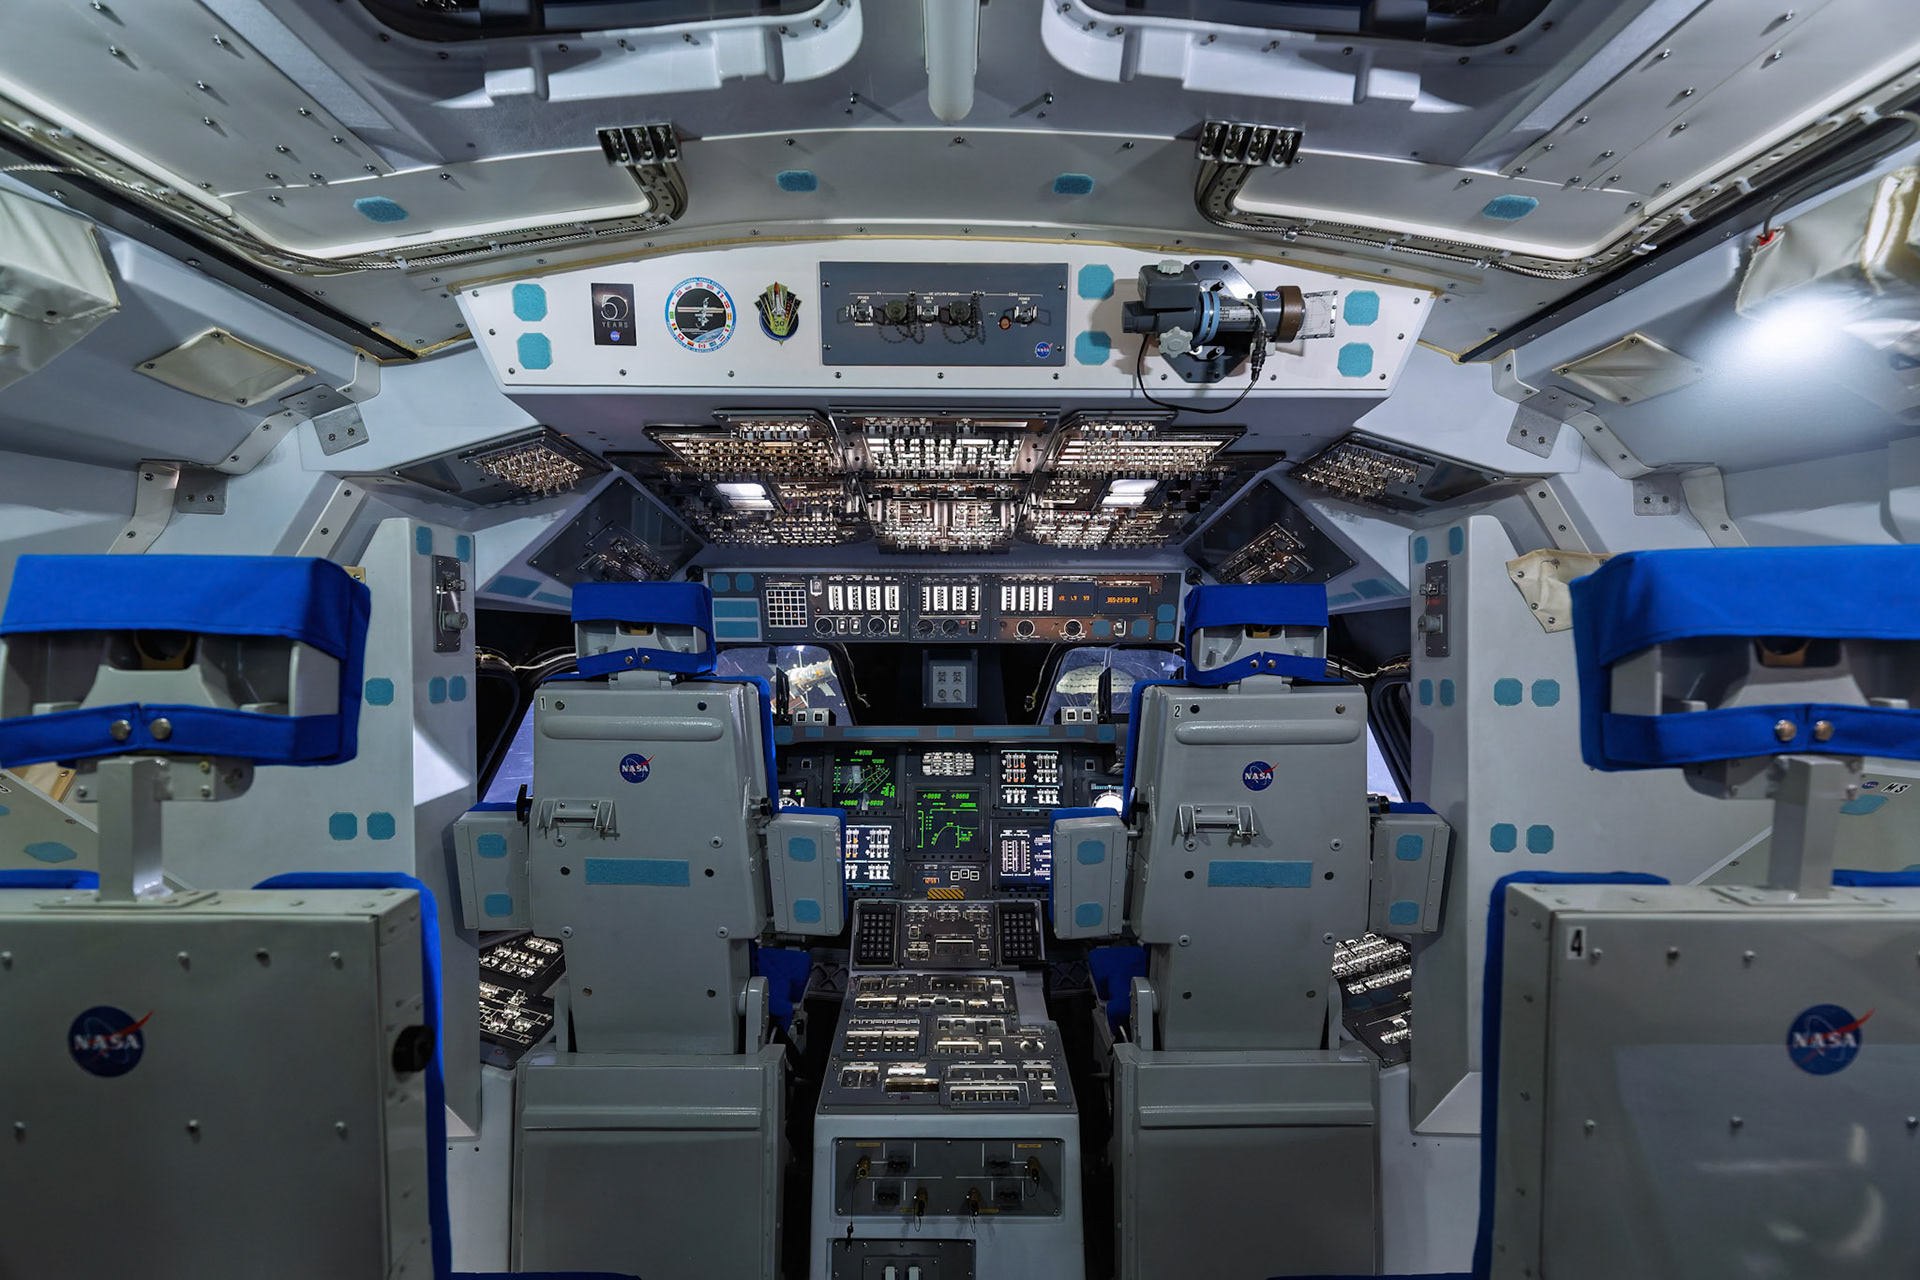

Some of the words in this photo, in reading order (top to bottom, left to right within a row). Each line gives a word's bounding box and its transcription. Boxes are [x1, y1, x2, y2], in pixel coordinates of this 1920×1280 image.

[601, 294, 628, 320] 50
[601, 321, 629, 329] YEARS
[541, 697, 545, 710] 1
[1174, 705, 1180, 718] 2
[621, 764, 649, 773] NASA
[1245, 772, 1272, 780] NASA
[1570, 929, 1584, 957] 4
[74, 1033, 140, 1051] NASA
[1792, 1031, 1857, 1049] NASA
